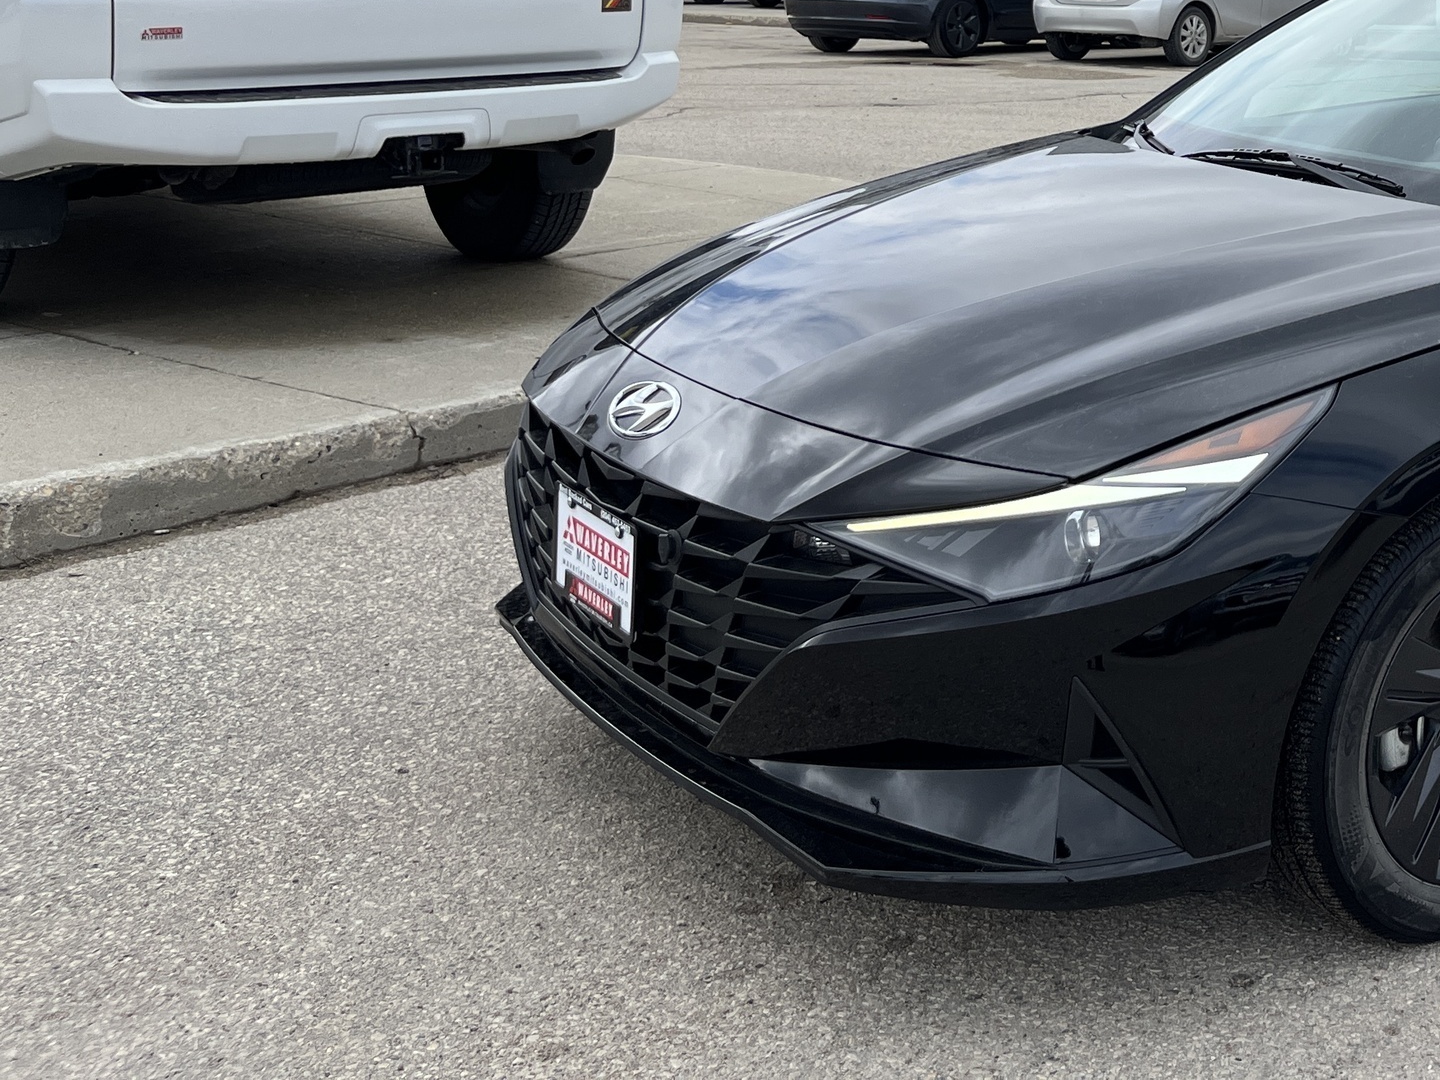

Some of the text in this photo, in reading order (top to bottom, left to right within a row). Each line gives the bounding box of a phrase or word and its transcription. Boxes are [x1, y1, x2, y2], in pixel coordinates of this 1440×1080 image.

[574, 520, 630, 574] WAVERLEY
[576, 547, 630, 594] MITSUBISHI
[577, 581, 613, 618] WAVERLEY
